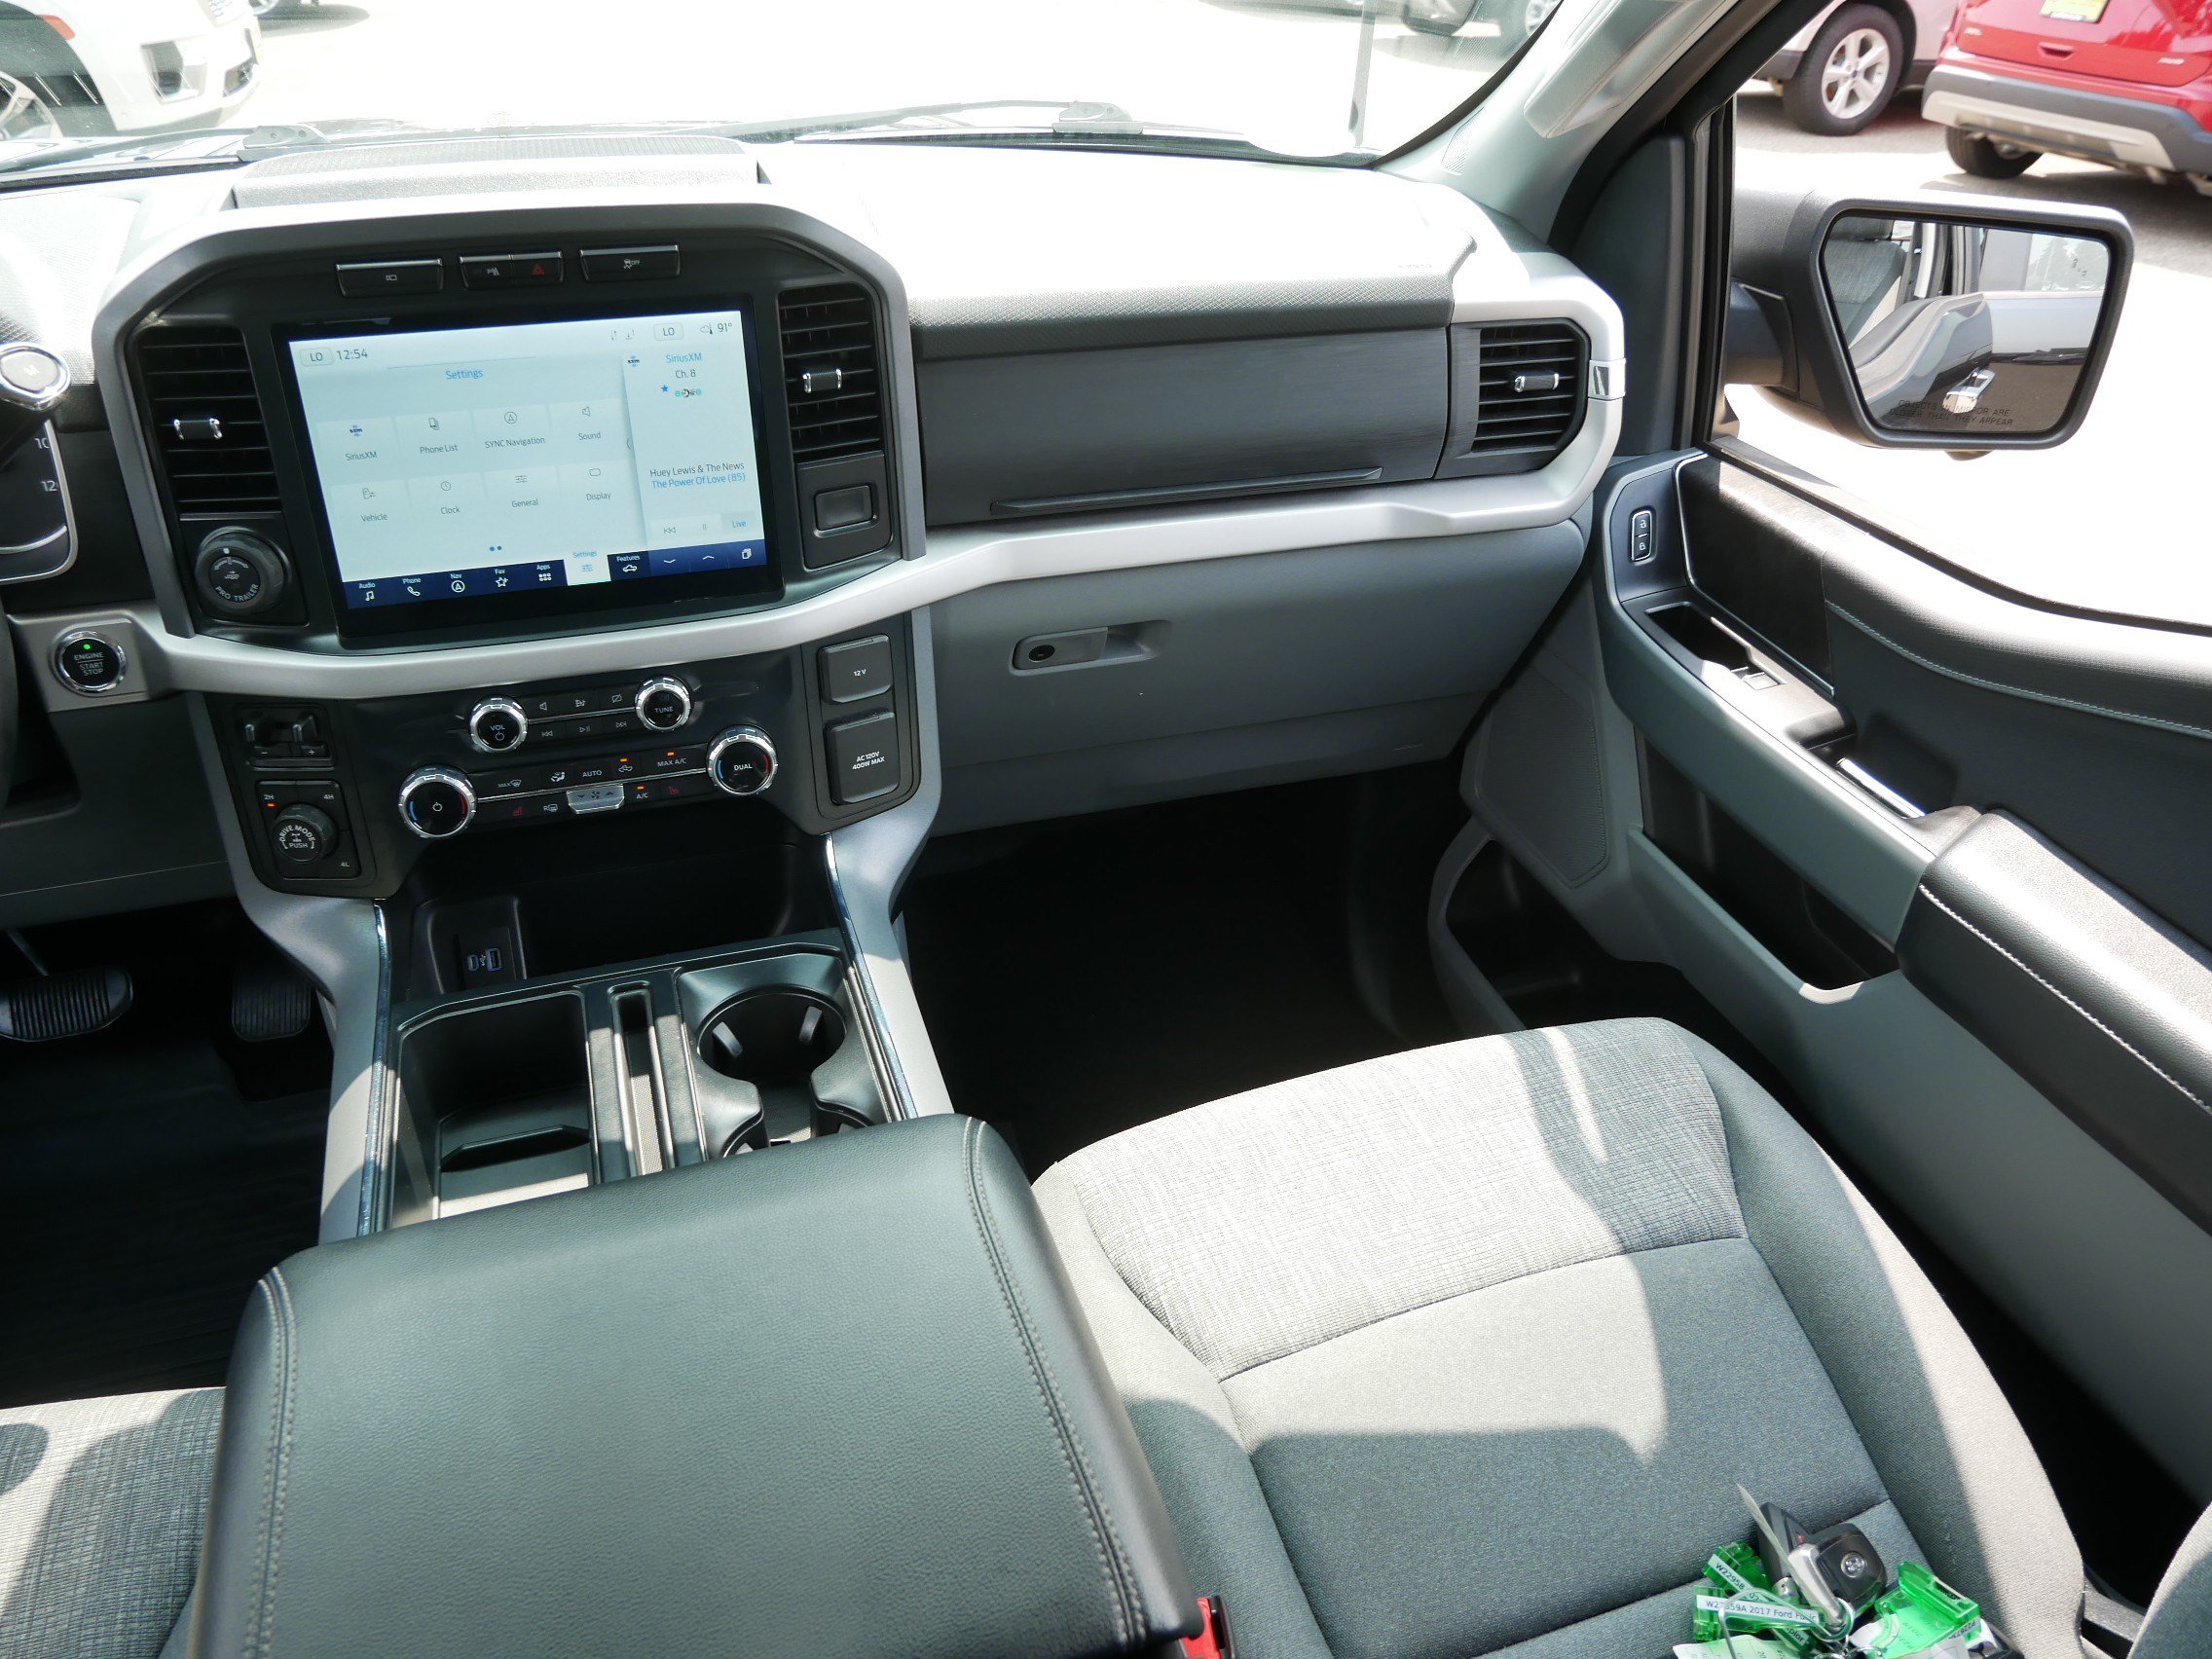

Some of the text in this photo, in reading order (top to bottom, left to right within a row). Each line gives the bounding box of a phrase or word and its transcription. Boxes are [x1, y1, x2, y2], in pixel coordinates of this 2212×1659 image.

[662, 327, 675, 336] LO
[310, 351, 323, 362] LO
[336, 349, 368, 360] 12:54
[665, 353, 702, 363] SiriusXM
[446, 368, 484, 380] Settings
[676, 369, 696, 379] Ch. 8
[1993, 407, 2009, 416] ARE
[1954, 413, 1976, 423] THEY
[1978, 416, 2013, 425] APPEAR
[578, 430, 602, 440] Sound
[484, 436, 545, 449] SYNC Navigation
[420, 443, 459, 455] Phone List
[345, 450, 378, 461] SiriusXM
[649, 468, 671, 478] Huey
[672, 466, 695, 476] Lewis
[706, 462, 720, 472] The
[721, 461, 745, 471] News
[41, 480, 58, 492] 12
[651, 480, 667, 490] The
[668, 478, 694, 489] Power
[695, 476, 706, 486] Of
[707, 474, 726, 485] Love
[586, 491, 610, 501] Display
[511, 498, 538, 508] General
[441, 506, 461, 515] Clock
[360, 513, 387, 522] Vehicle
[572, 550, 598, 559] Settings
[215, 584, 259, 602] PRO TRAILER
[73, 651, 104, 661] ENGINE
[79, 661, 103, 671] START
[83, 668, 104, 677] STOP
[866, 751, 880, 759] 120V
[657, 759, 674, 768] MAX
[852, 756, 885, 770] 400W MAX
[278, 825, 316, 842] DRIVE MODE
[1706, 1601, 1747, 1612] W259A
[1749, 1605, 1771, 1615] 2017
[1773, 1608, 1792, 1619] Ford
